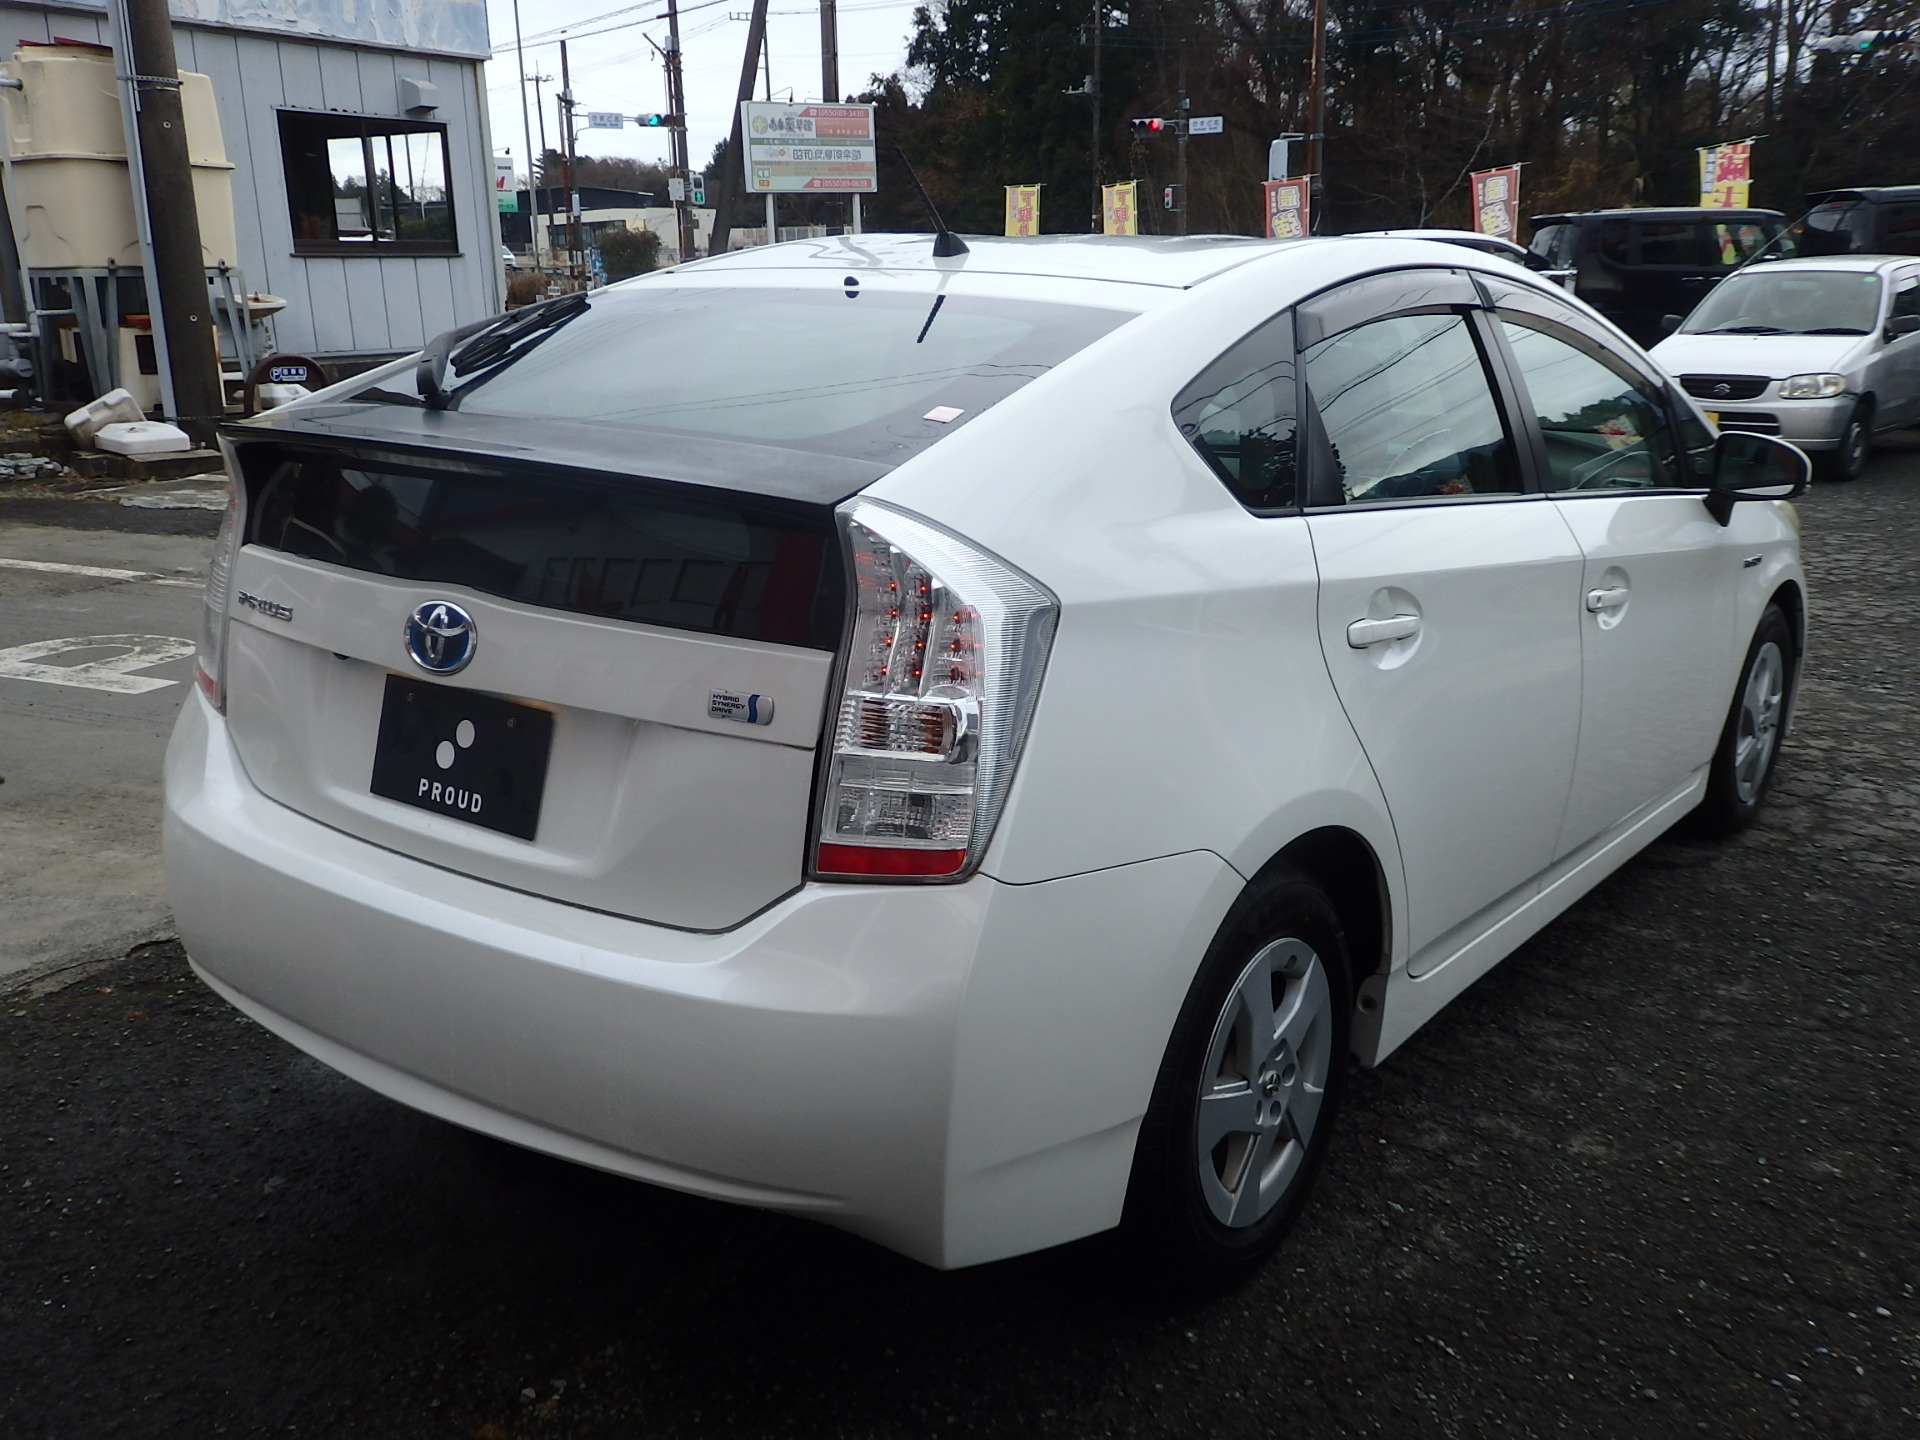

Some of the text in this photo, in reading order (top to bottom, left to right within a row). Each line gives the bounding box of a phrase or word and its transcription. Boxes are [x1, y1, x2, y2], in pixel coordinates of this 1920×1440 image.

[238, 590, 293, 621] PRIUS
[712, 694, 740, 702] HYBRID
[711, 700, 746, 709] SYNERGY
[711, 706, 733, 714] DRIVE
[418, 778, 482, 813] PROUD
